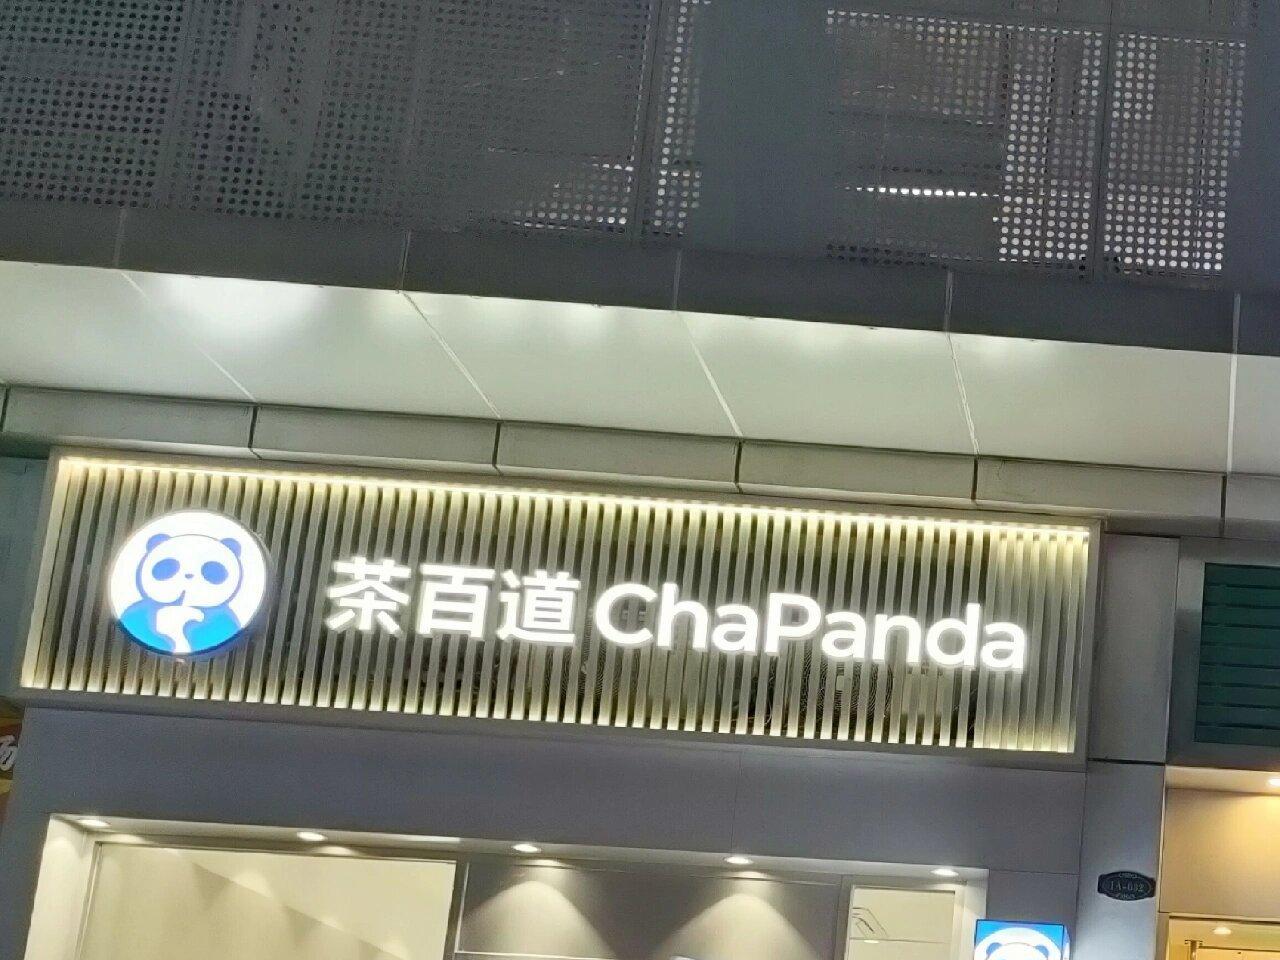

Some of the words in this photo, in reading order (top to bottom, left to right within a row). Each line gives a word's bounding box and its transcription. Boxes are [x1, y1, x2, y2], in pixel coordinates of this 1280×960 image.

[327, 556, 581, 646] 茶百道
[593, 580, 1028, 672] ChaPanda
